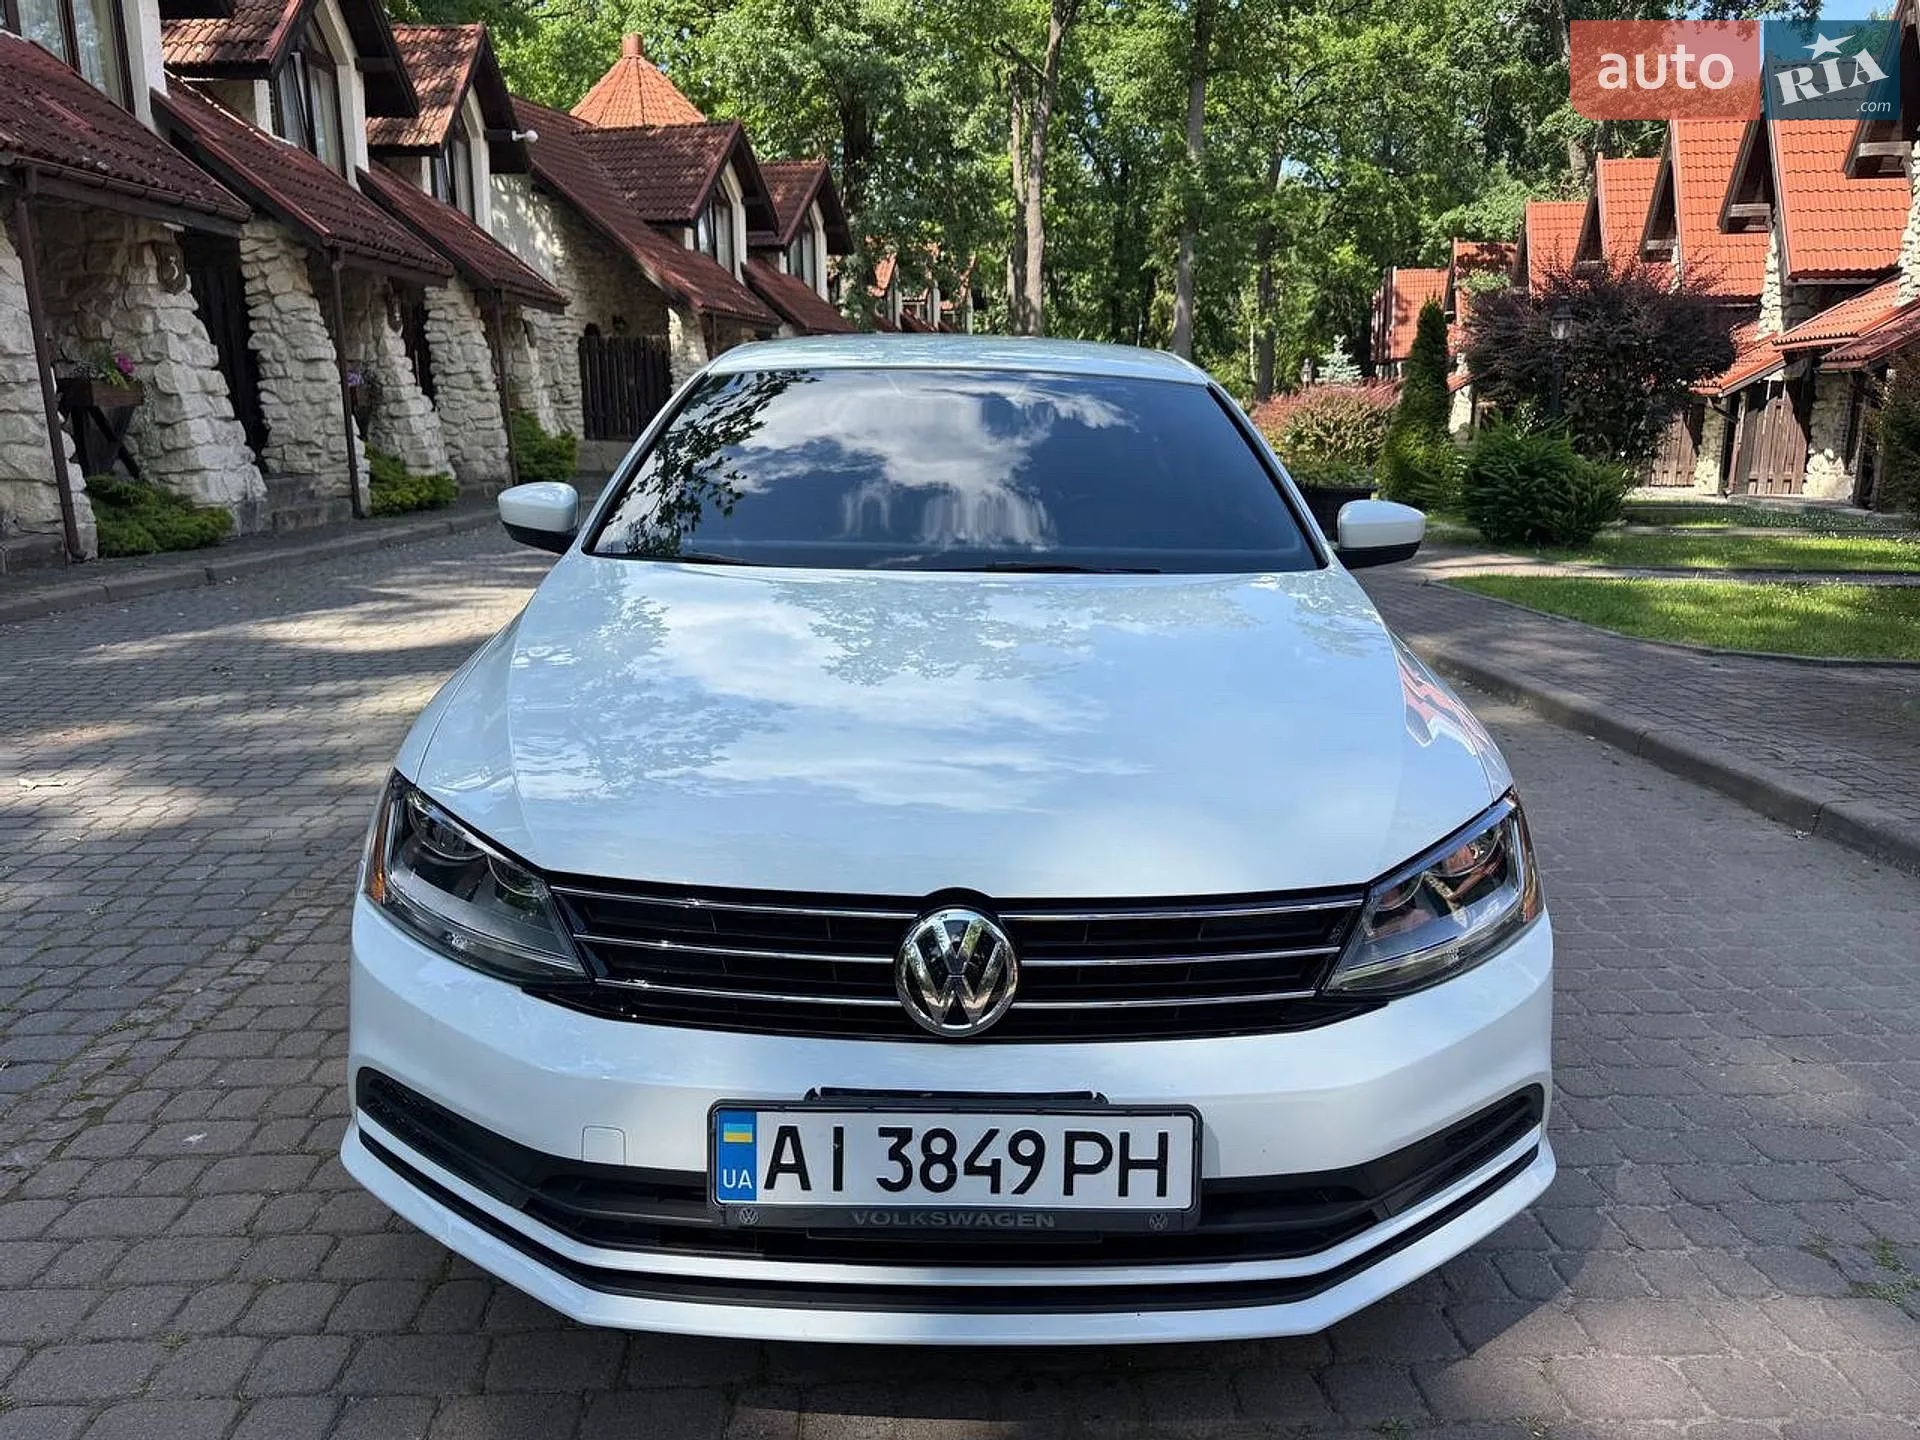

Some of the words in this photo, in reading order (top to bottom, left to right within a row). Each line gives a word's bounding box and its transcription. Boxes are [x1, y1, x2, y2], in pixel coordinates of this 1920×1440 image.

[763, 1124, 845, 1193] AI
[876, 1126, 1047, 1196] 3849
[1062, 1130, 1169, 1198] PH
[722, 1168, 753, 1190] UA
[850, 1209, 1057, 1229] VOLKSWAGEN
